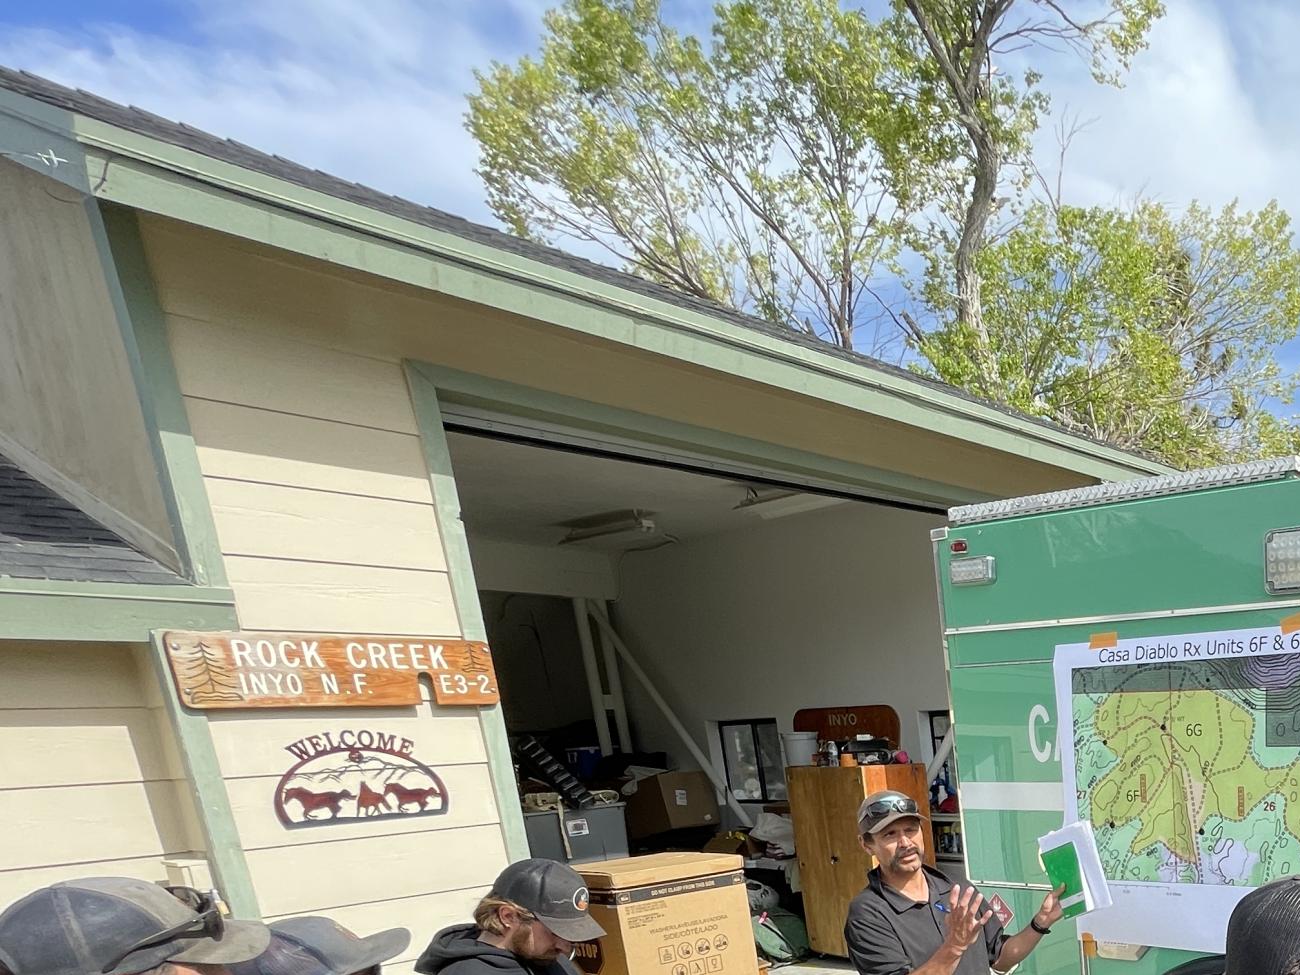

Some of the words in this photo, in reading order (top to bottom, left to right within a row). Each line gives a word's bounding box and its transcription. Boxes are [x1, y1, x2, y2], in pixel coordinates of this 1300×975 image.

[230, 639, 326, 669] ROCK
[345, 642, 449, 670] CREEK
[1099, 648, 1130, 663] Casa
[1135, 644, 1178, 661] Diablo
[1183, 642, 1201, 657] Rx
[1206, 638, 1244, 656] Units
[1249, 636, 1268, 652] 6F
[1272, 634, 1285, 650] &
[238, 673, 304, 696] INYO
[828, 713, 857, 726] INYO
[1185, 723, 1203, 737] 6G
[284, 729, 415, 761] WELCOME
[1126, 789, 1140, 803] 6F
[1263, 801, 1276, 812] 26
[575, 942, 598, 959] STOP
